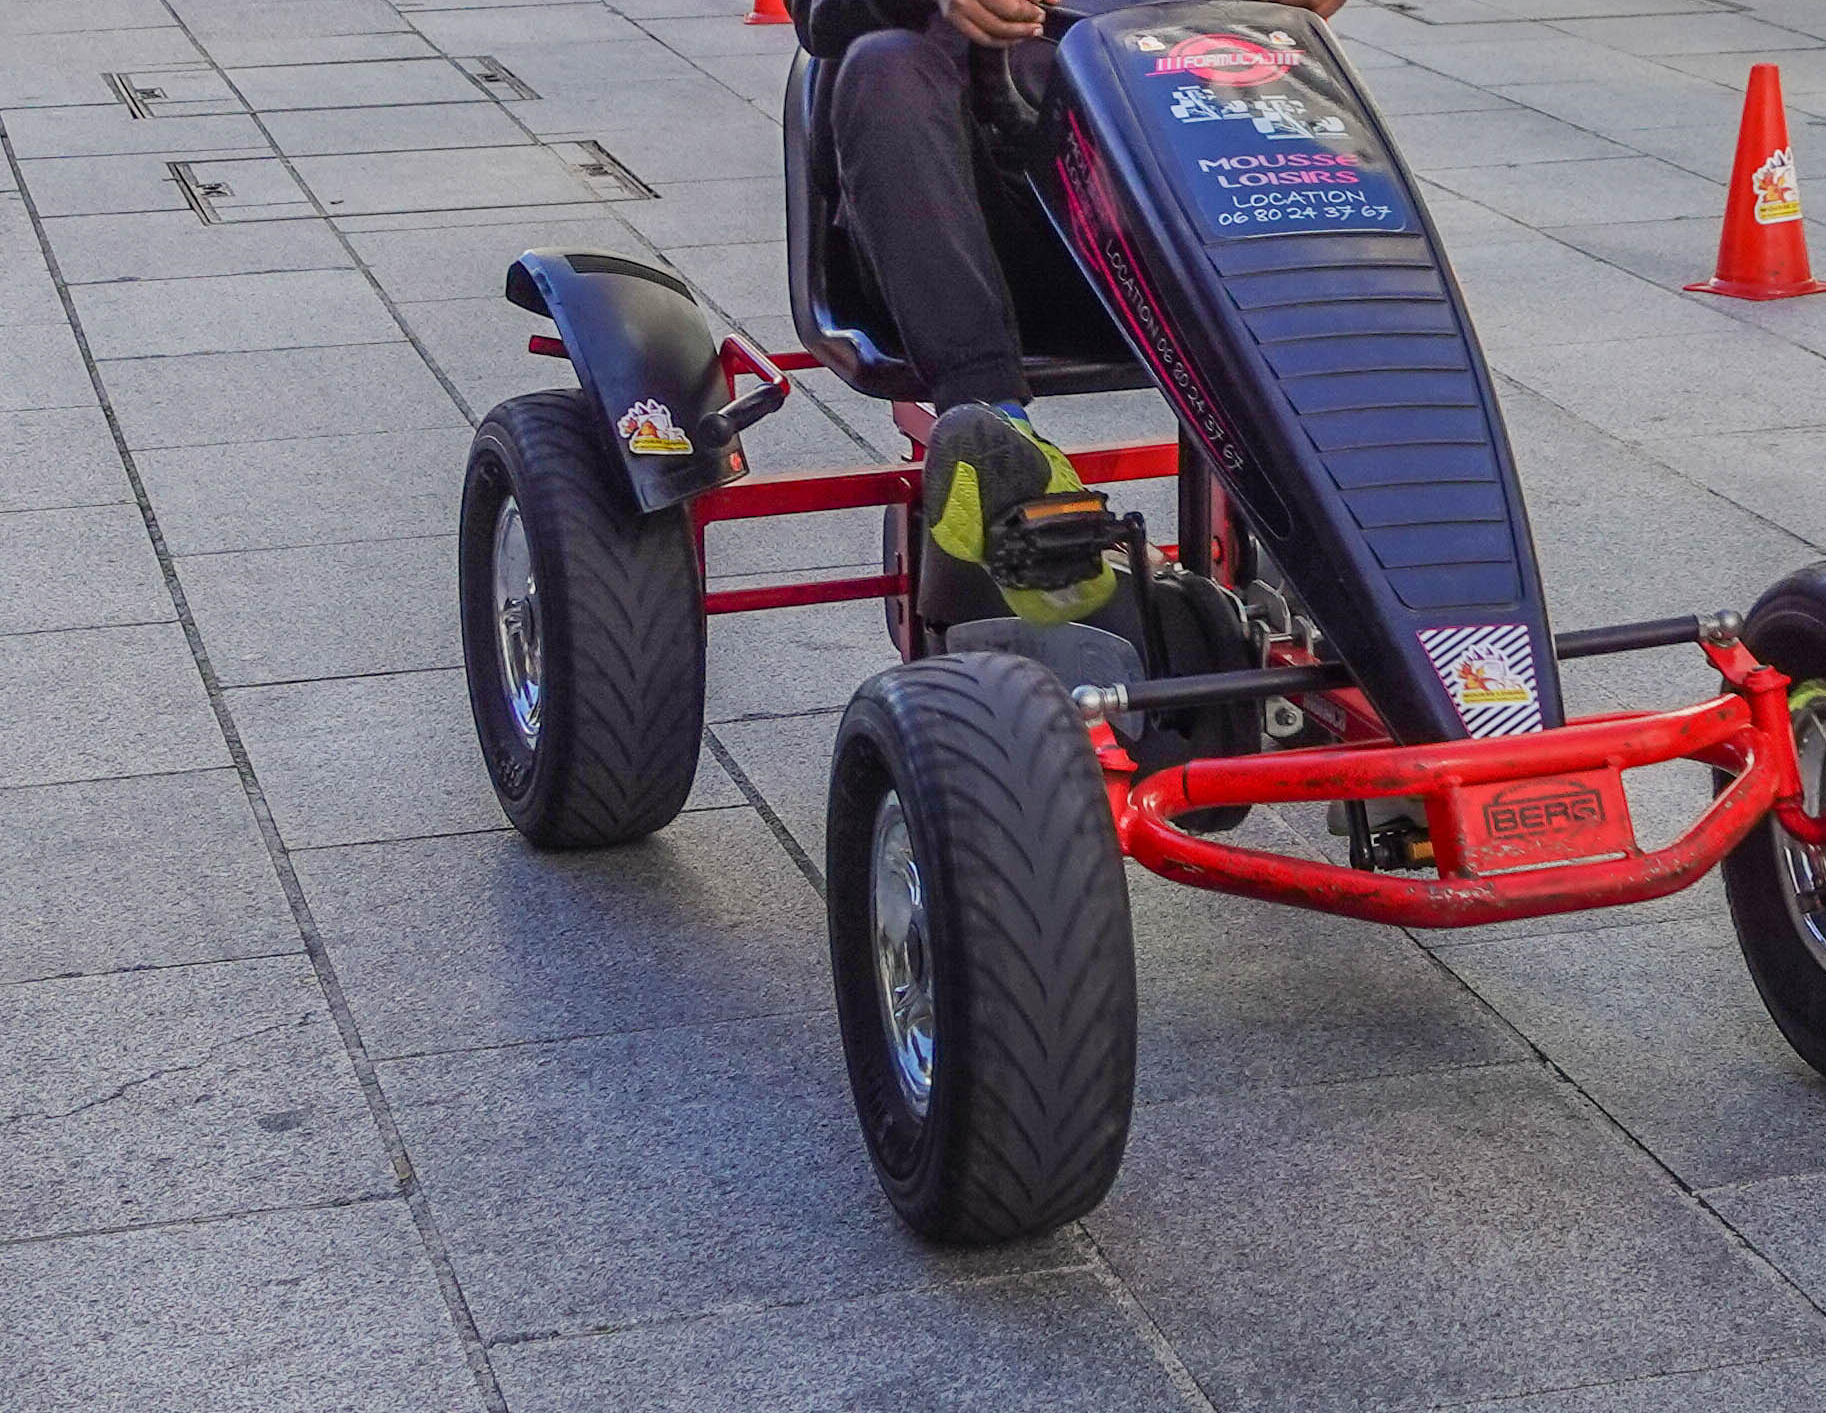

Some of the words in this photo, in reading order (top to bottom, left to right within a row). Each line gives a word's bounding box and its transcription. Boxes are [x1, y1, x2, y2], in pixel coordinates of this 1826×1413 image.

[1197, 153, 1363, 173] MOUSSE
[1216, 170, 1361, 189] LOISIRS
[1231, 189, 1368, 209] LOCATION
[1218, 212, 1249, 226] 06
[1253, 208, 1283, 223] 80
[1287, 206, 1318, 221] 24
[1323, 205, 1356, 221] 37
[1361, 204, 1393, 221] 67
[1105, 239, 1160, 339] LOCATION
[1156, 337, 1173, 364] 06
[1203, 413, 1226, 442] 37
[1222, 443, 1244, 471] 67
